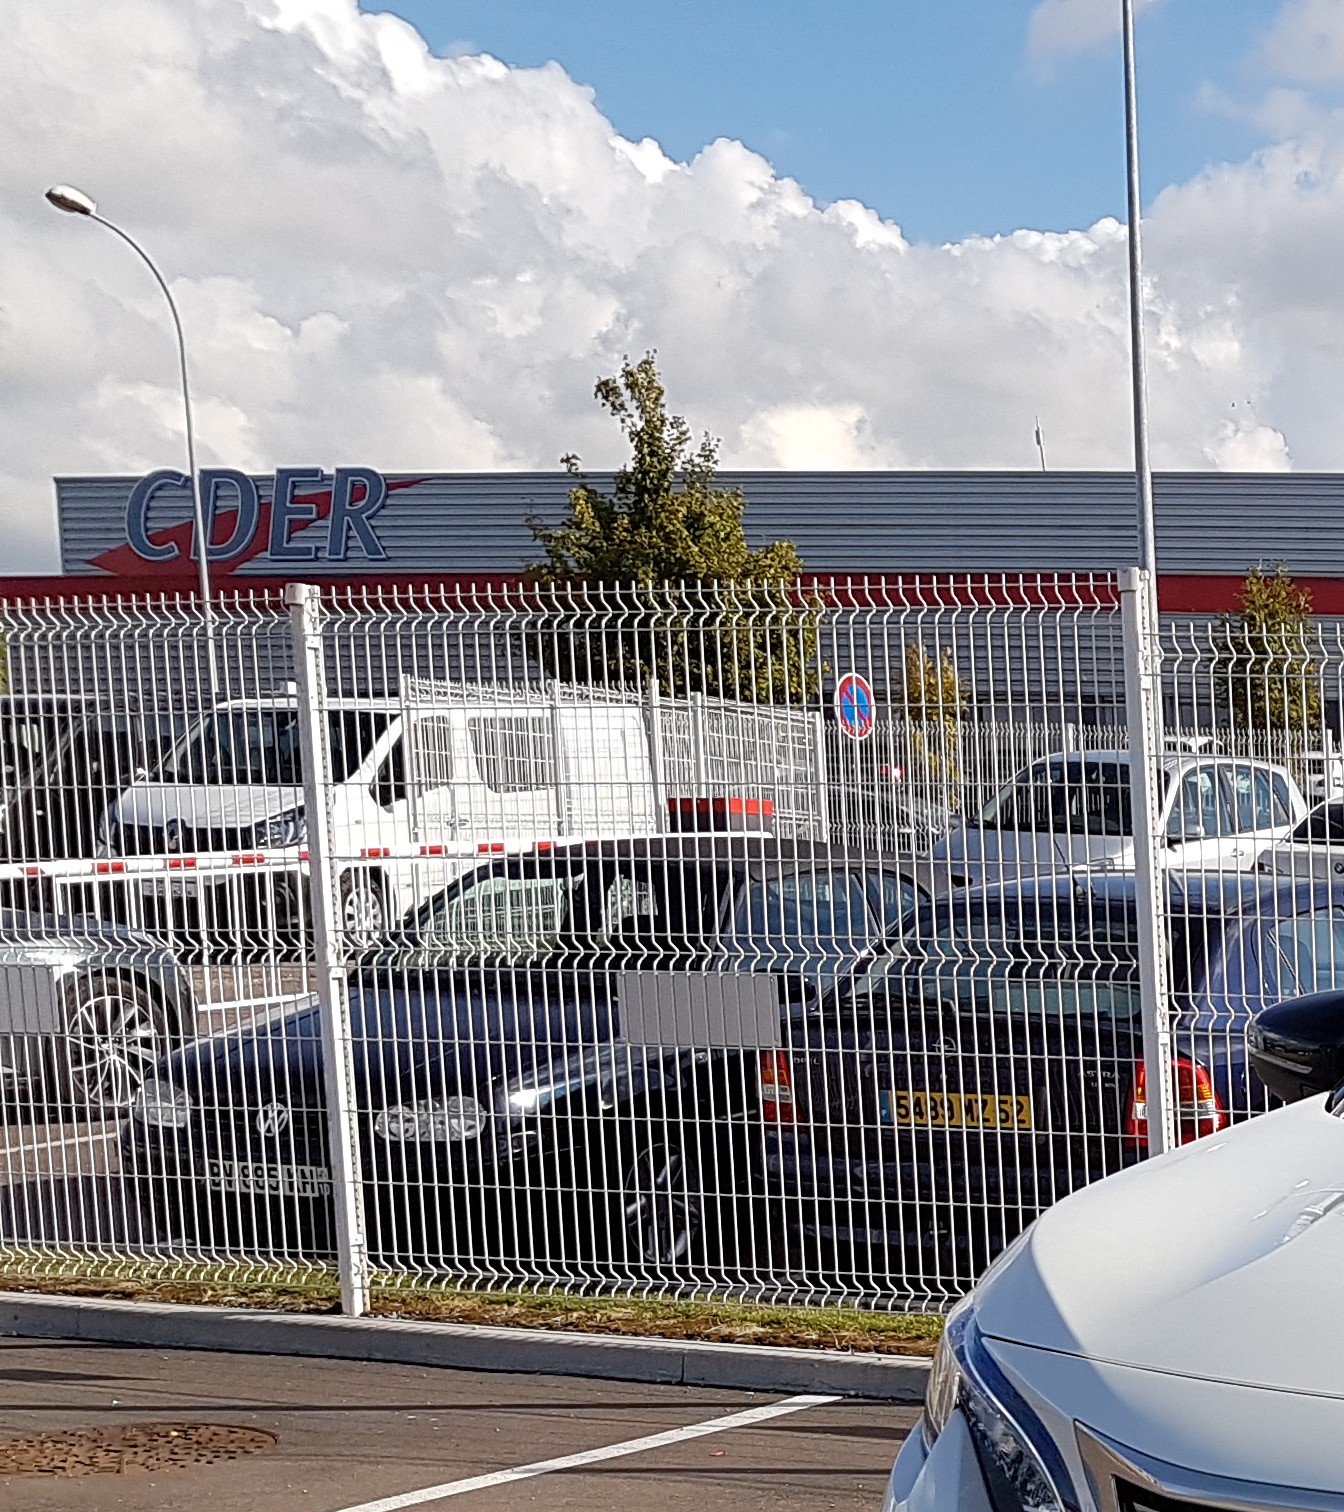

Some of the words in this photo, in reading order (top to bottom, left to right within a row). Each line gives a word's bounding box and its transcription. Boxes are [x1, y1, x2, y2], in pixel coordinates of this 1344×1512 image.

[125, 466, 388, 560] CDER
[896, 1096, 955, 1120] 5489
[999, 1100, 1027, 1124] 52
